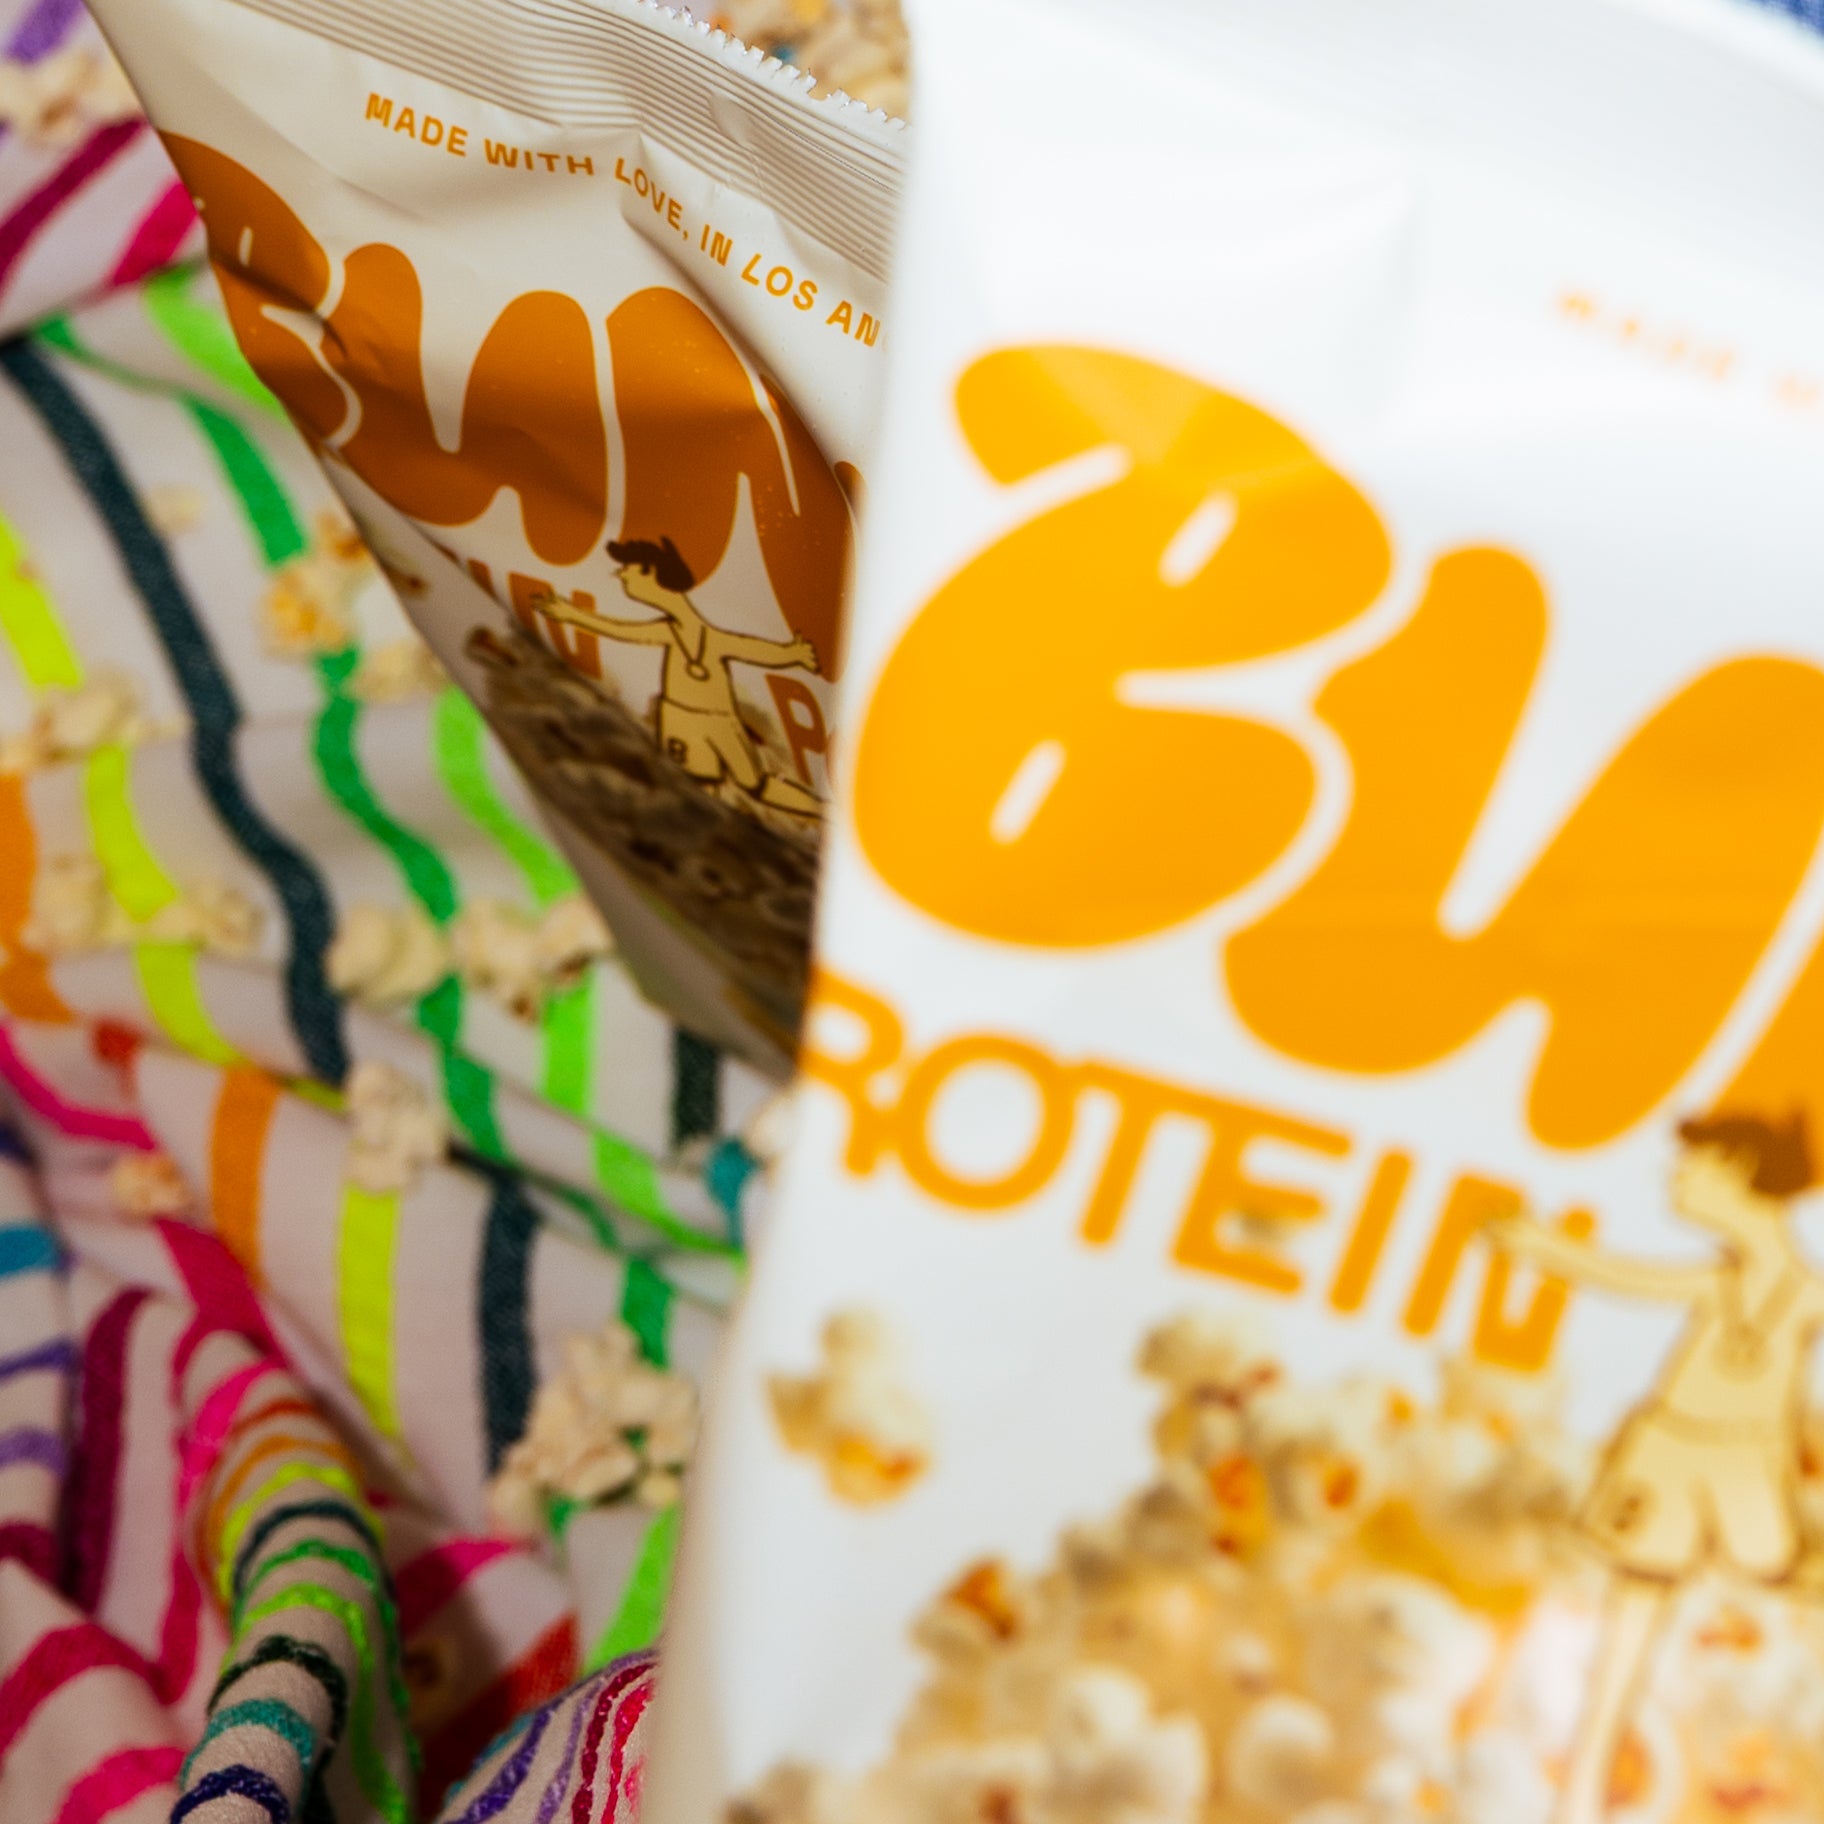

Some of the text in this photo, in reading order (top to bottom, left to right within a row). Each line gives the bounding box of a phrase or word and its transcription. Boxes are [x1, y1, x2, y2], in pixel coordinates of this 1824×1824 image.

[158, 129, 862, 685] BUN
[363, 91, 889, 349] MADE WITH LOVE, IN LOS AN
[805, 964, 1593, 1375] ROTEIN
